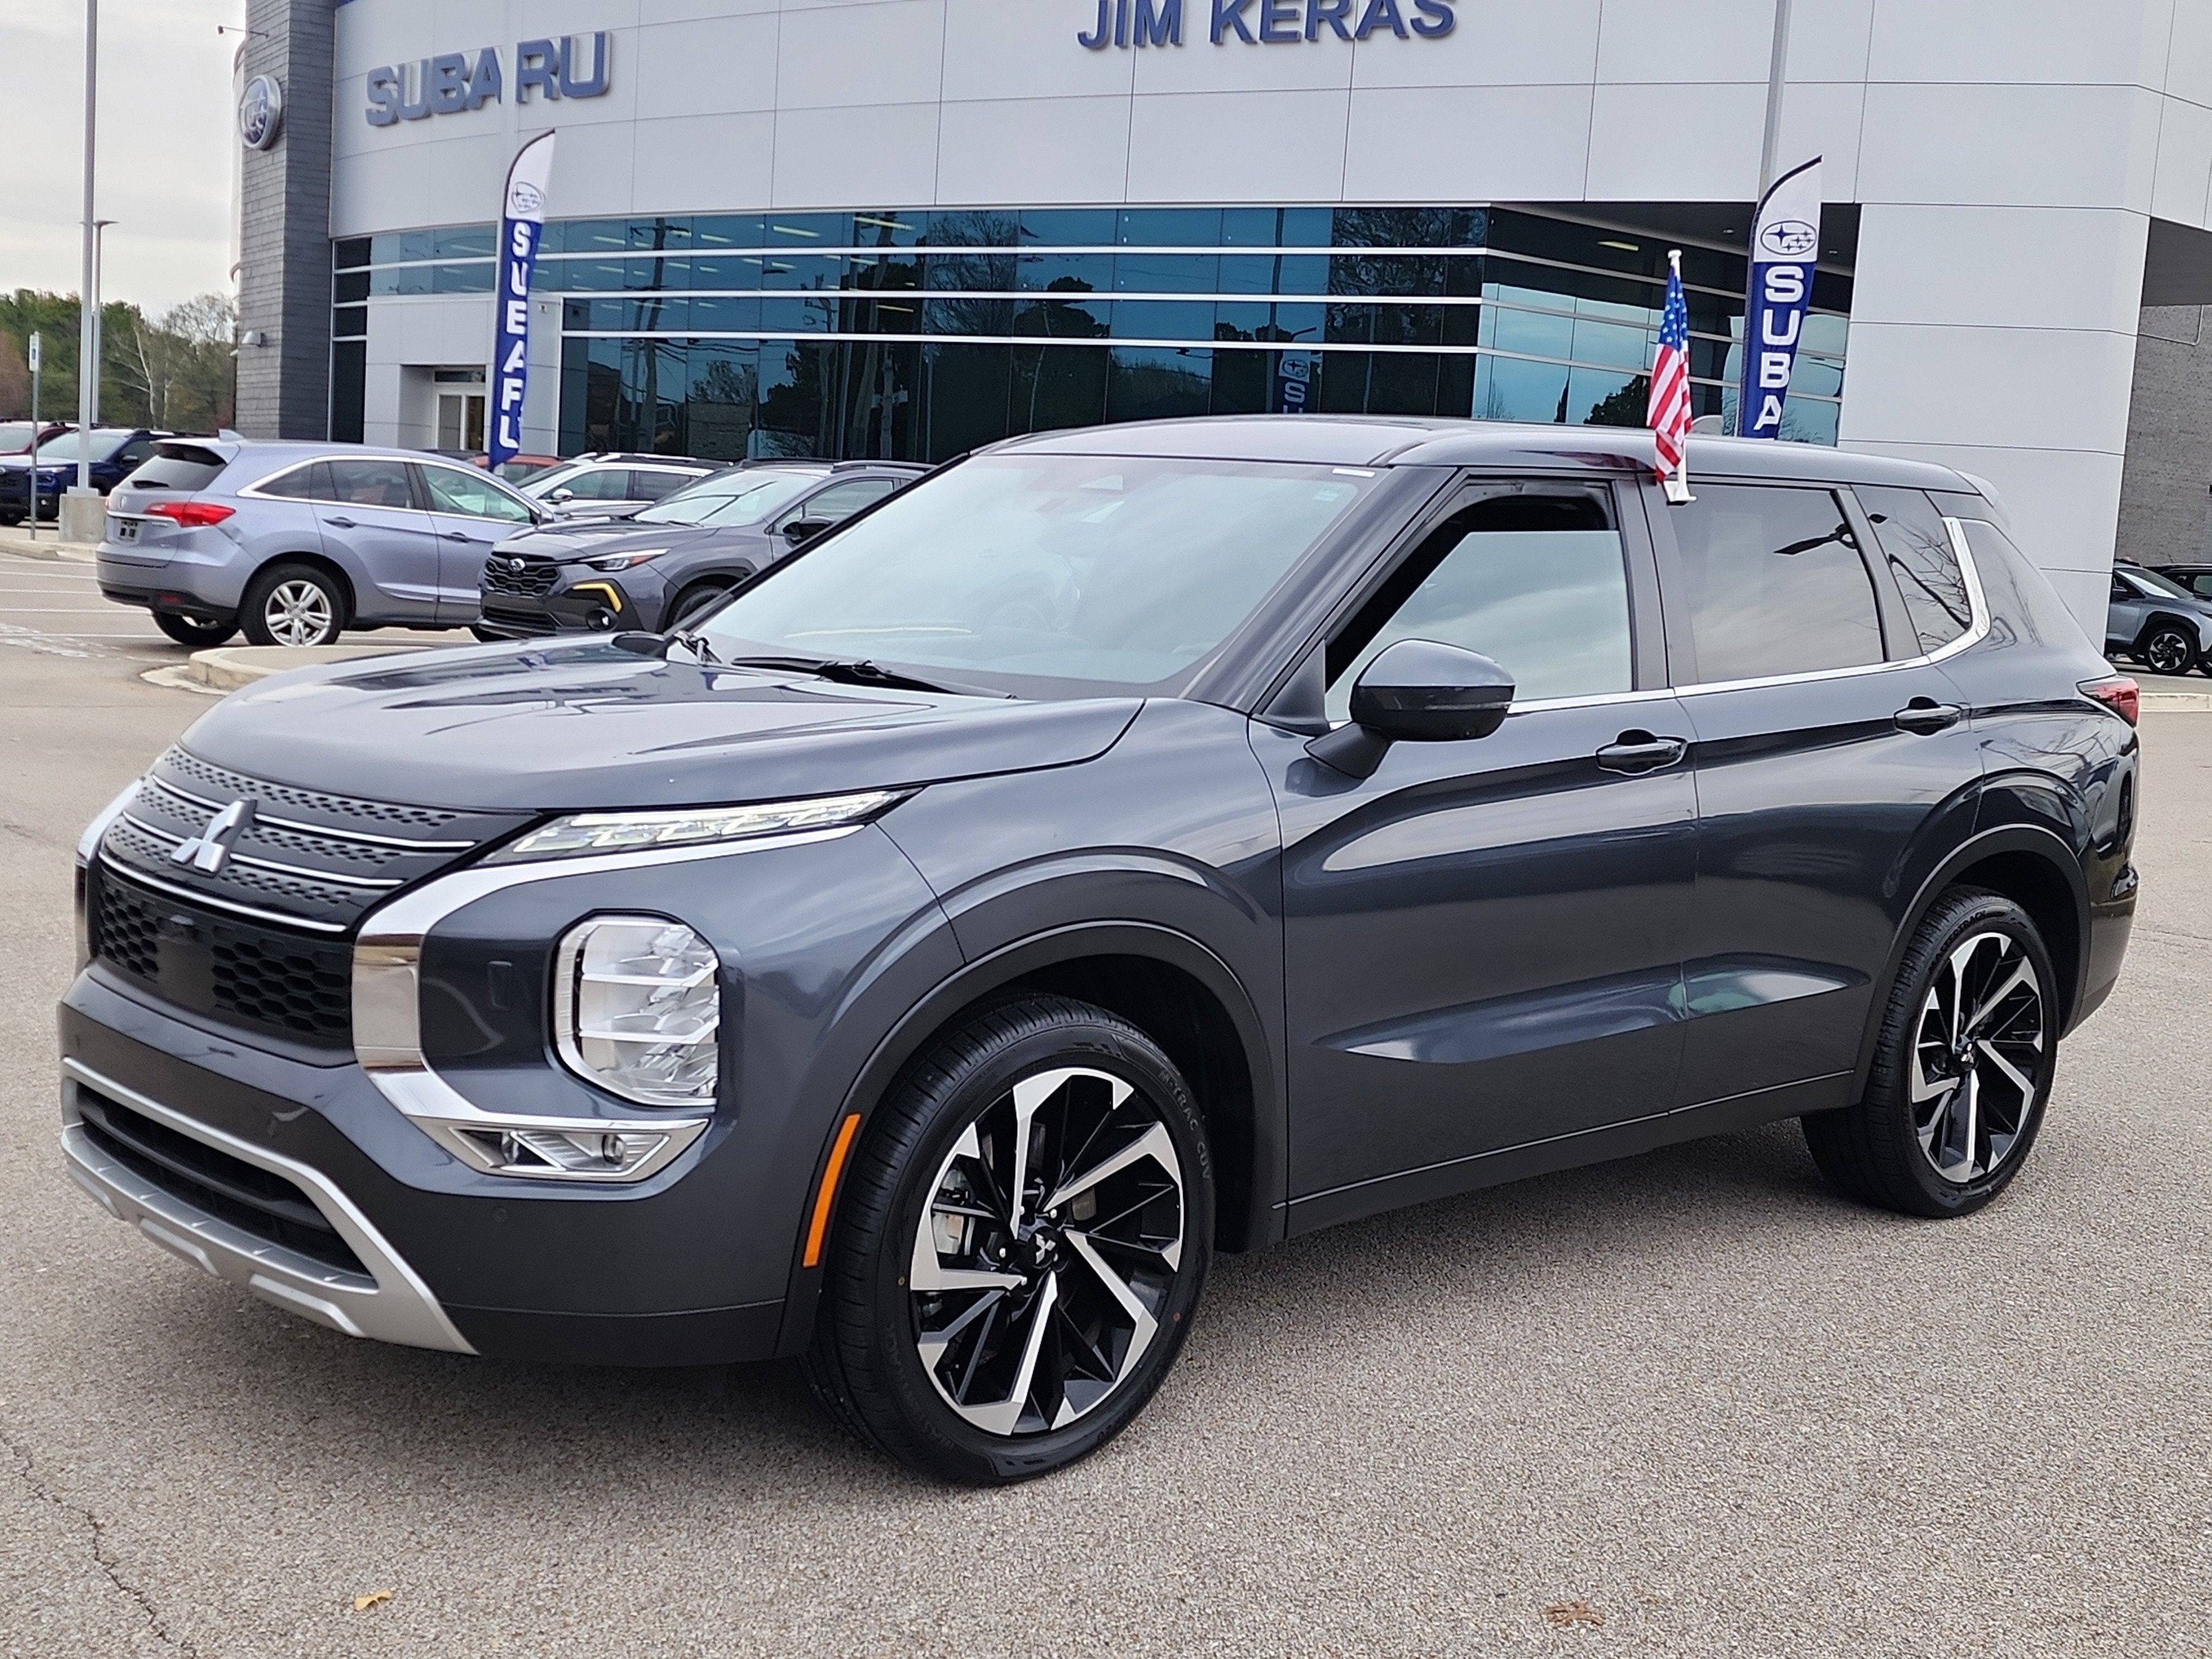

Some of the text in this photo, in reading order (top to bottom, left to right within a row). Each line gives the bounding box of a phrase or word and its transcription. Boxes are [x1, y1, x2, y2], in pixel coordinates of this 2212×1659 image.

[1077, 0, 1456, 50] JIM KERAS
[366, 31, 612, 127] SUBARU
[1753, 265, 1804, 440] SUBA
[1159, 1070, 1211, 1178] M-TRAC CUV
